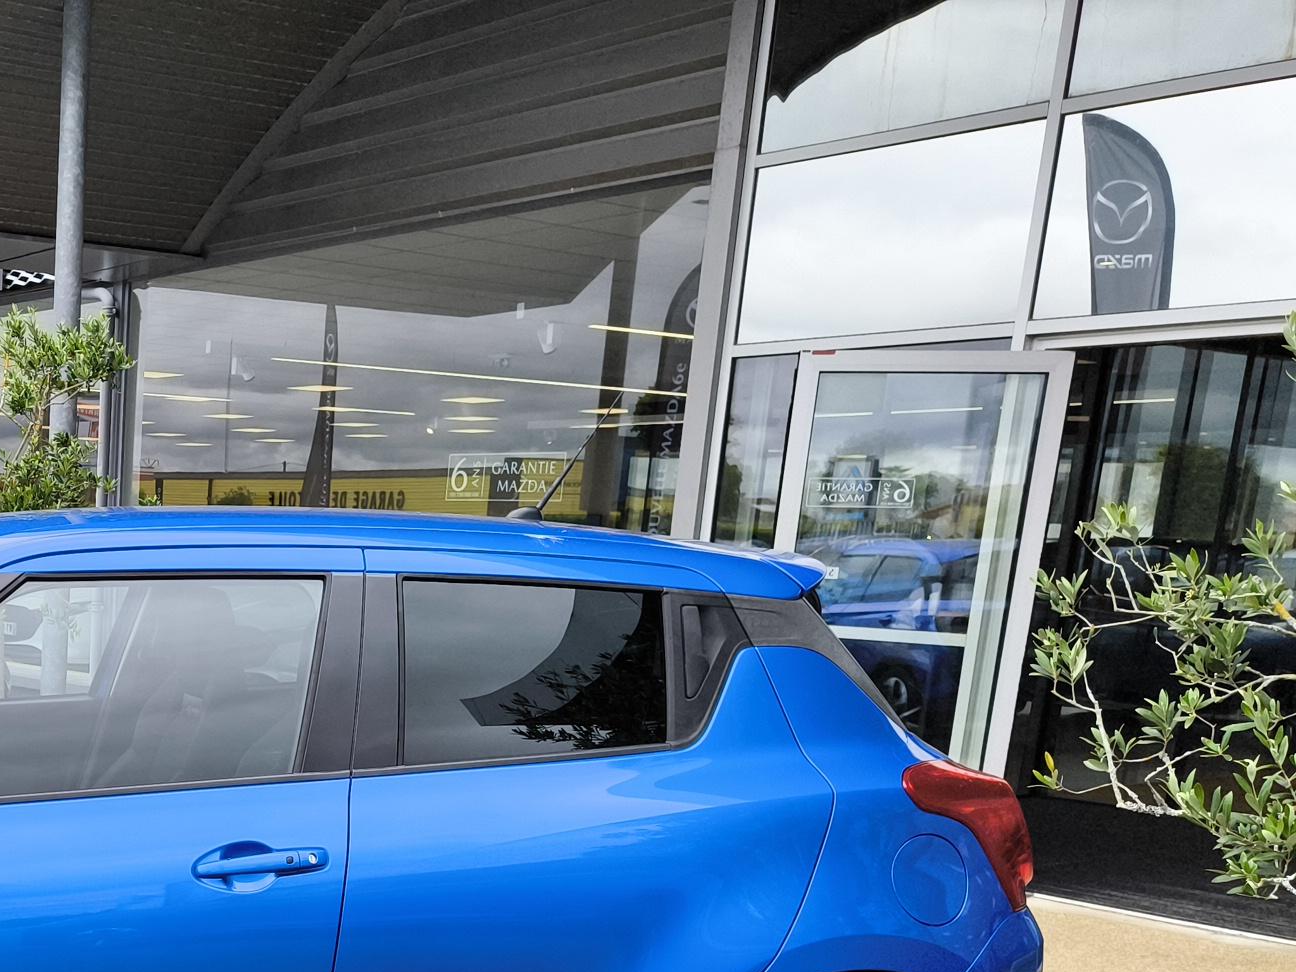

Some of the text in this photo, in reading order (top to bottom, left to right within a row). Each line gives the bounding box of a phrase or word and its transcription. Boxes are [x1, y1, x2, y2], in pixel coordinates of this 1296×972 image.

[450, 457, 468, 492] 6
[471, 461, 482, 488] ANS
[491, 461, 557, 475] GARANTIE
[496, 480, 546, 493] MAZDA
